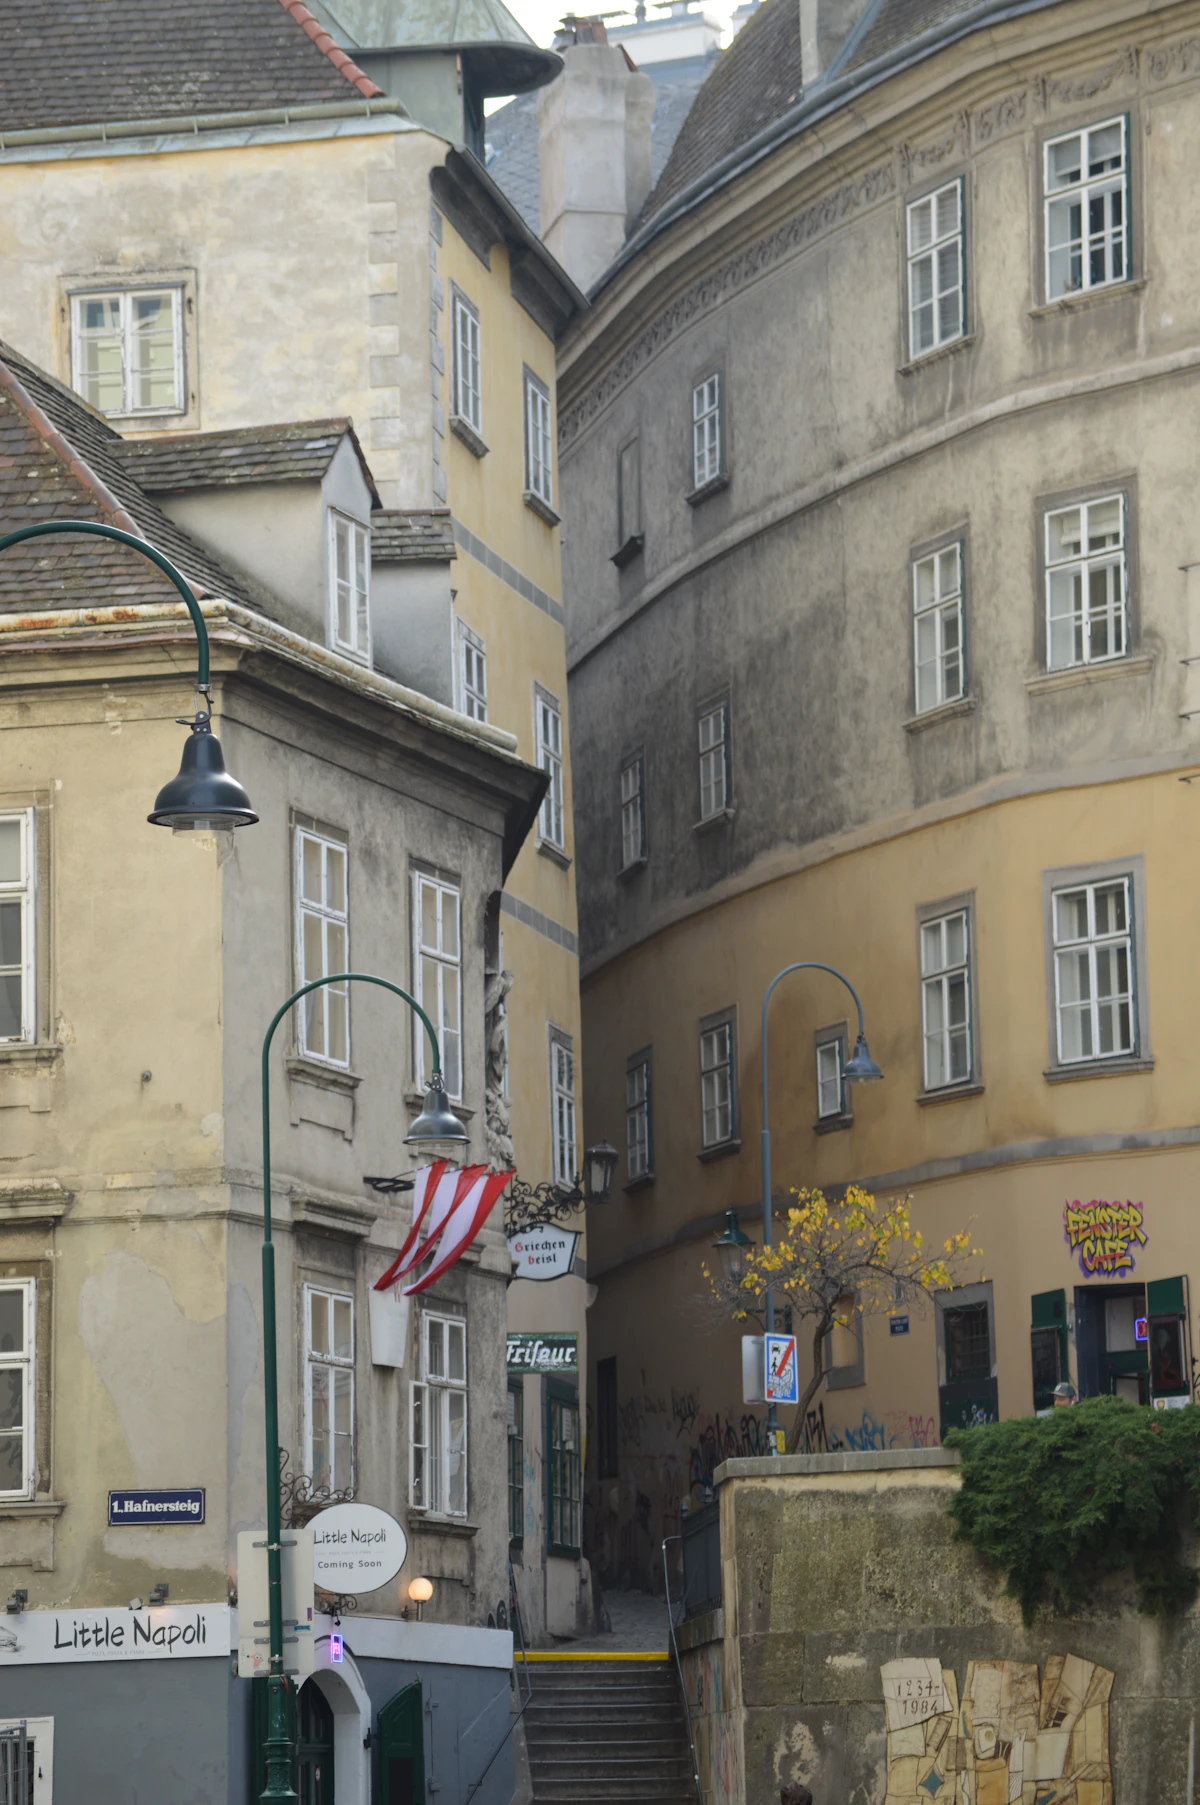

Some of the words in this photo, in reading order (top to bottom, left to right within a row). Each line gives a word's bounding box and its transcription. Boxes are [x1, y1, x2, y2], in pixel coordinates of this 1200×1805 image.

[1066, 1203, 1148, 1249] FENSTER
[515, 1240, 565, 1253] Griechen
[527, 1253, 557, 1265] beisl
[1082, 1238, 1133, 1273] CAFE
[314, 1529, 348, 1545] Little
[351, 1528, 387, 1547] Napoli
[317, 1561, 354, 1570] Coming
[358, 1560, 382, 1568] Soon
[54, 1616, 125, 1649] Little
[133, 1613, 206, 1654] Napoli
[902, 1699, 938, 1715] 1984
